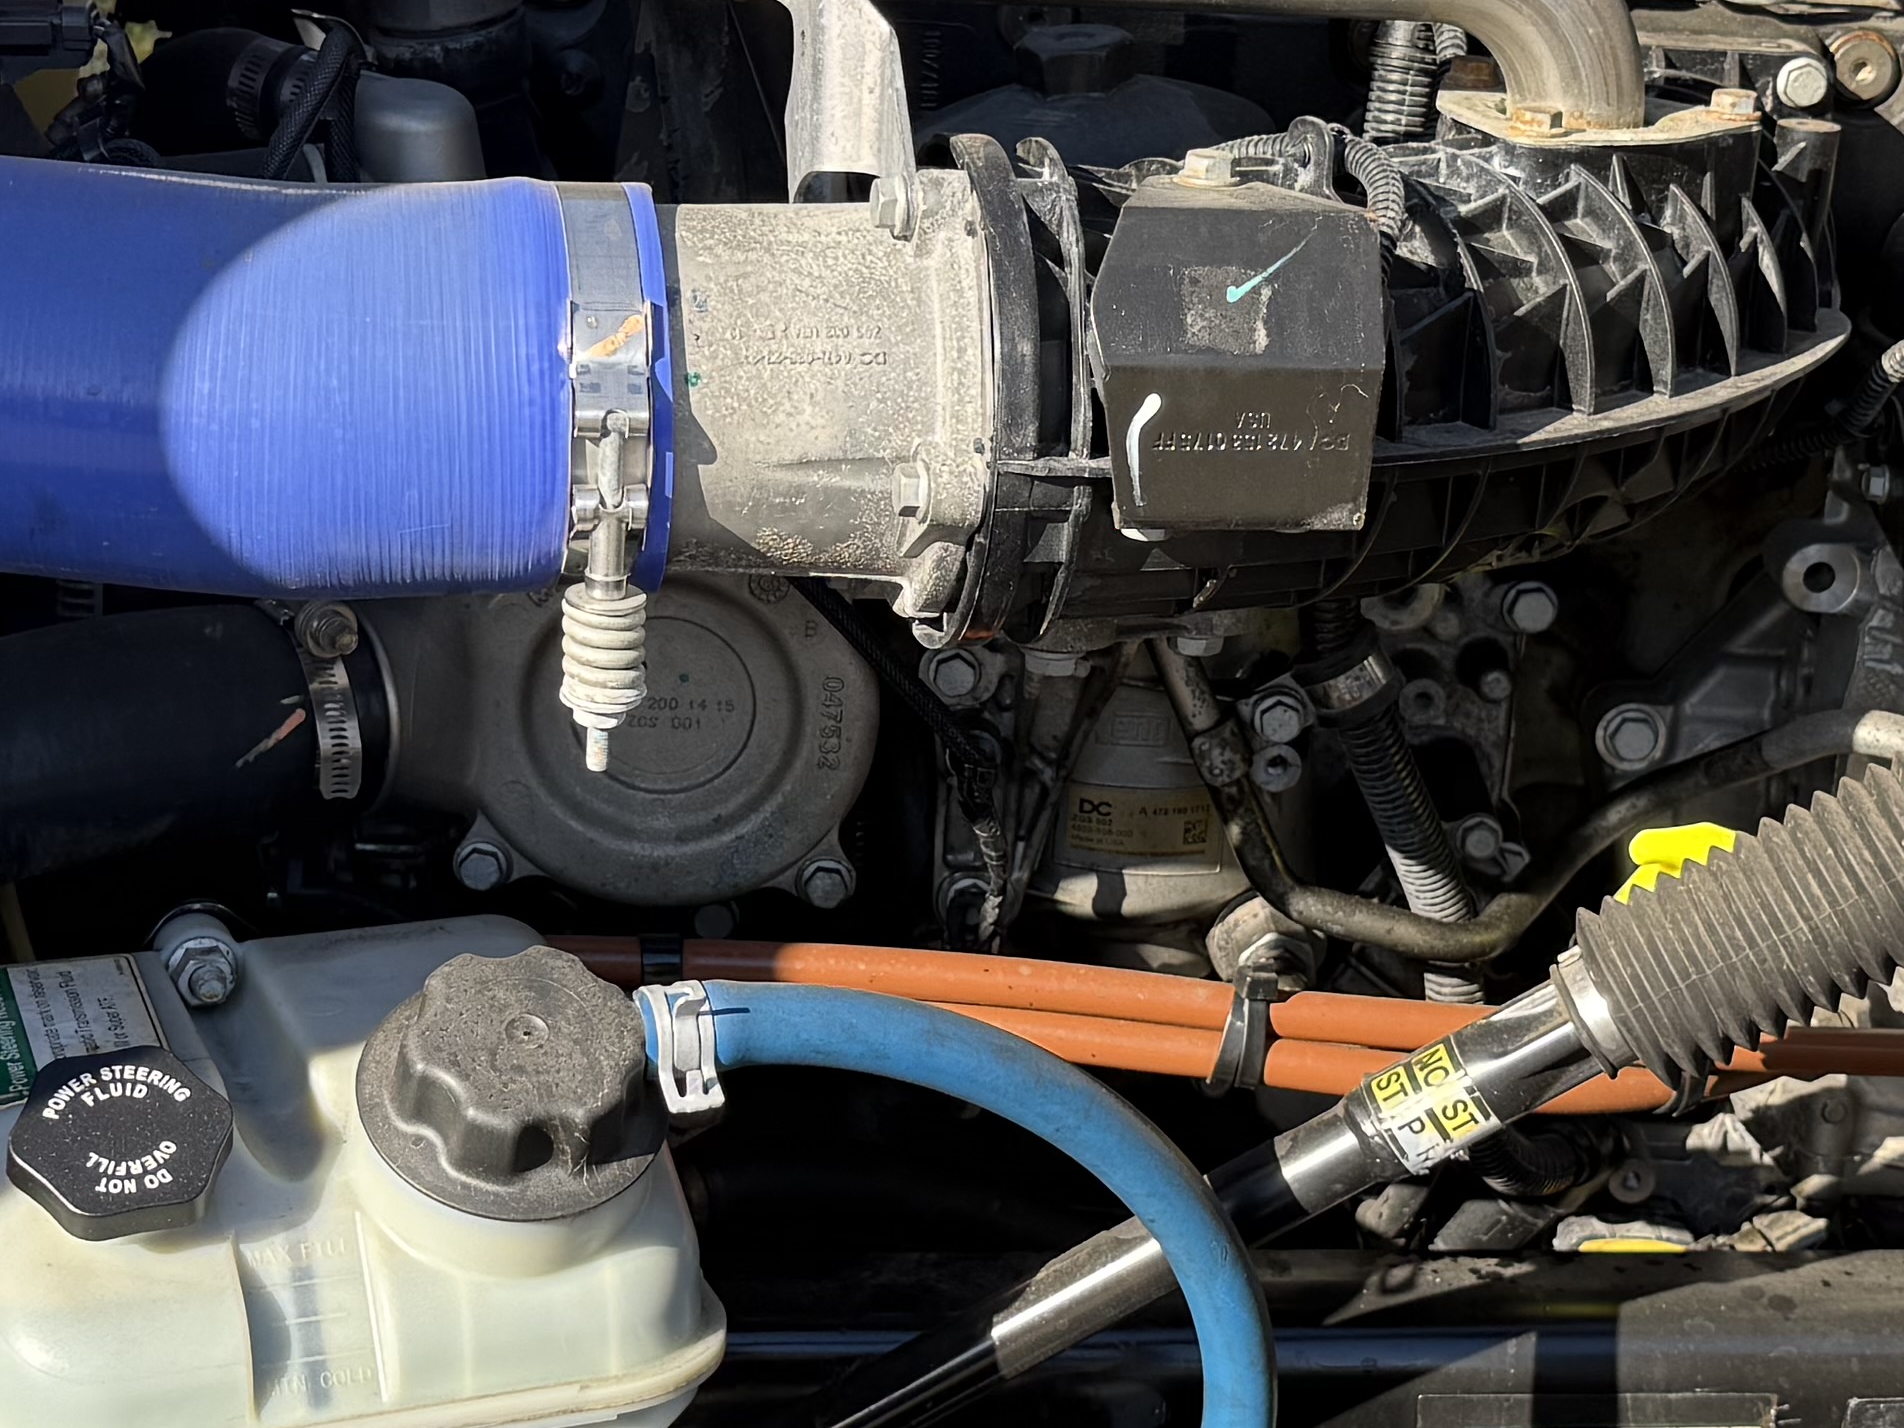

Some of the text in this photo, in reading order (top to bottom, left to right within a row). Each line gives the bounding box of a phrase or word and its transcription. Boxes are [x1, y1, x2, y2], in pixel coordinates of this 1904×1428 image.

[1237, 412, 1271, 429] USA
[816, 677, 844, 771] 047532
[1079, 798, 1112, 816] DC
[59, 971, 90, 1032] Transmission Fluid
[7, 1062, 29, 1092] Power
[42, 1066, 191, 1119] POWER STEERING
[81, 1083, 148, 1107] FLUID
[86, 1140, 177, 1176] OVERFILL
[95, 1169, 173, 1194] DO NOT
[246, 1239, 346, 1265] MAX FILL
[320, 1369, 373, 1389] COLD
